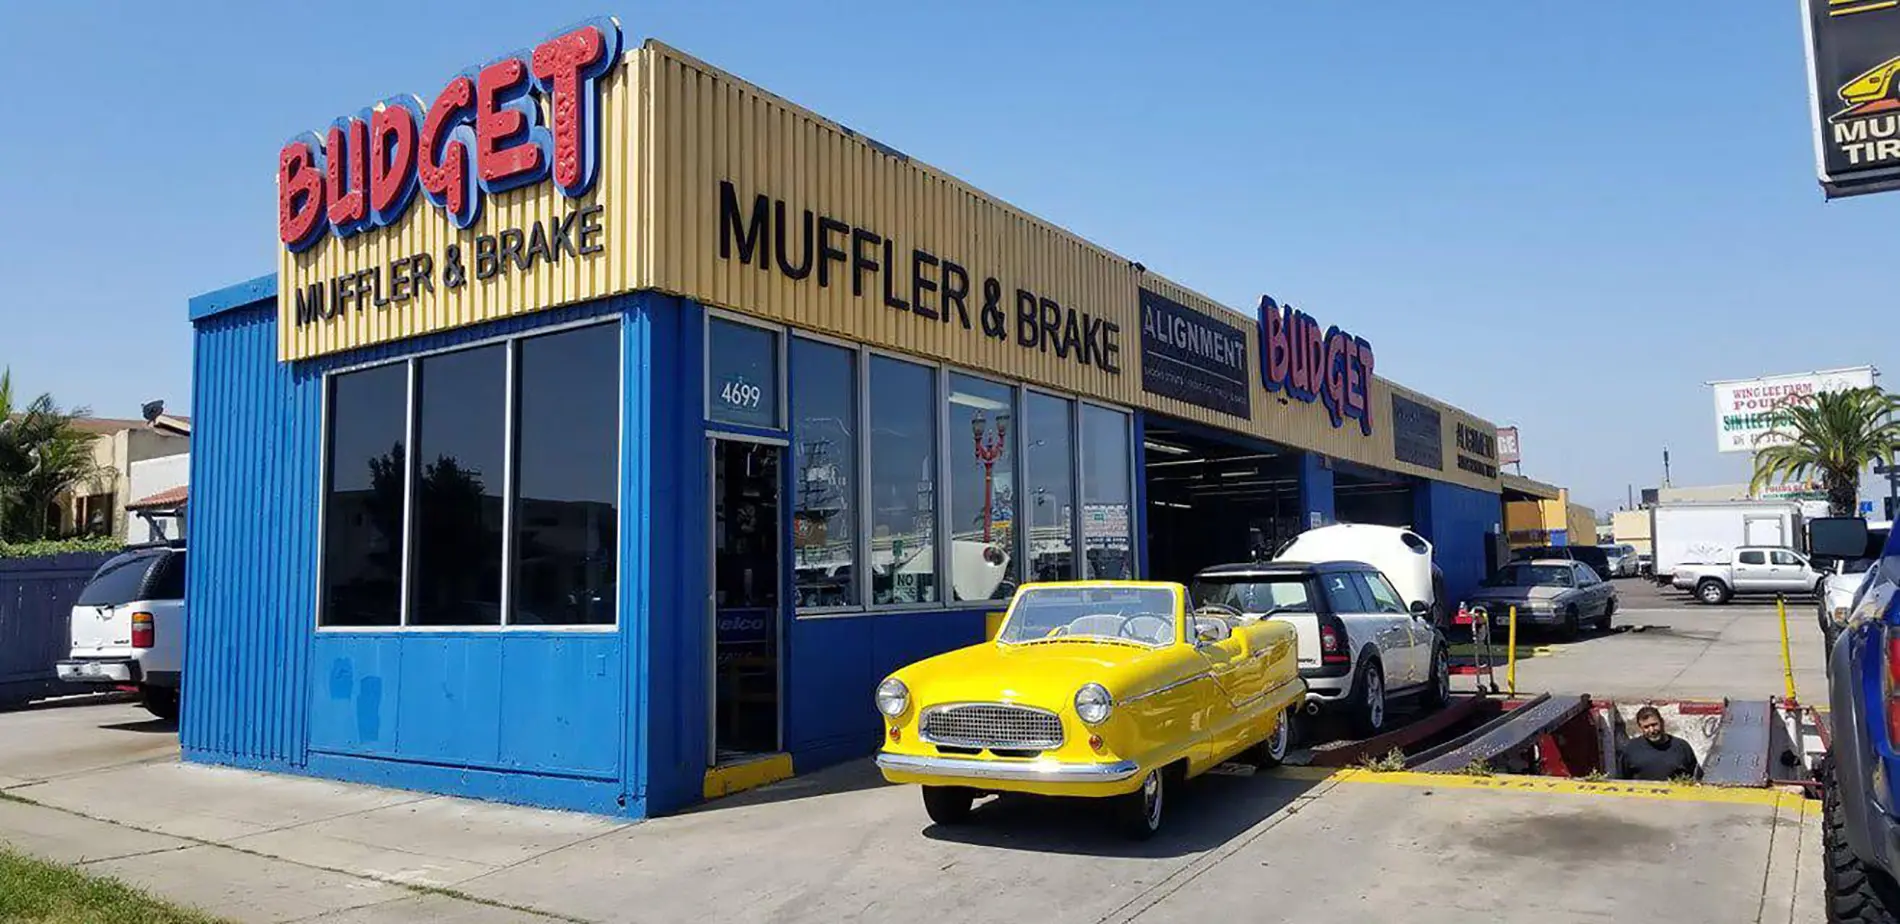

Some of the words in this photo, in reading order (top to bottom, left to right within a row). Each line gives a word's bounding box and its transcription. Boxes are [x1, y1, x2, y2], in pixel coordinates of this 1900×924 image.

[277, 22, 605, 246] BUDGET
[295, 251, 434, 327] MUFFLER
[443, 244, 467, 289] &
[475, 204, 605, 281] BRAKE
[719, 180, 972, 330] MUFFLER
[983, 277, 1007, 341] &
[1016, 288, 1121, 375] BRAKE
[721, 382, 761, 408] 4699
[1144, 304, 1244, 371] ALIGNMENT
[1263, 301, 1374, 434] BUDGET
[897, 573, 914, 587] NO
